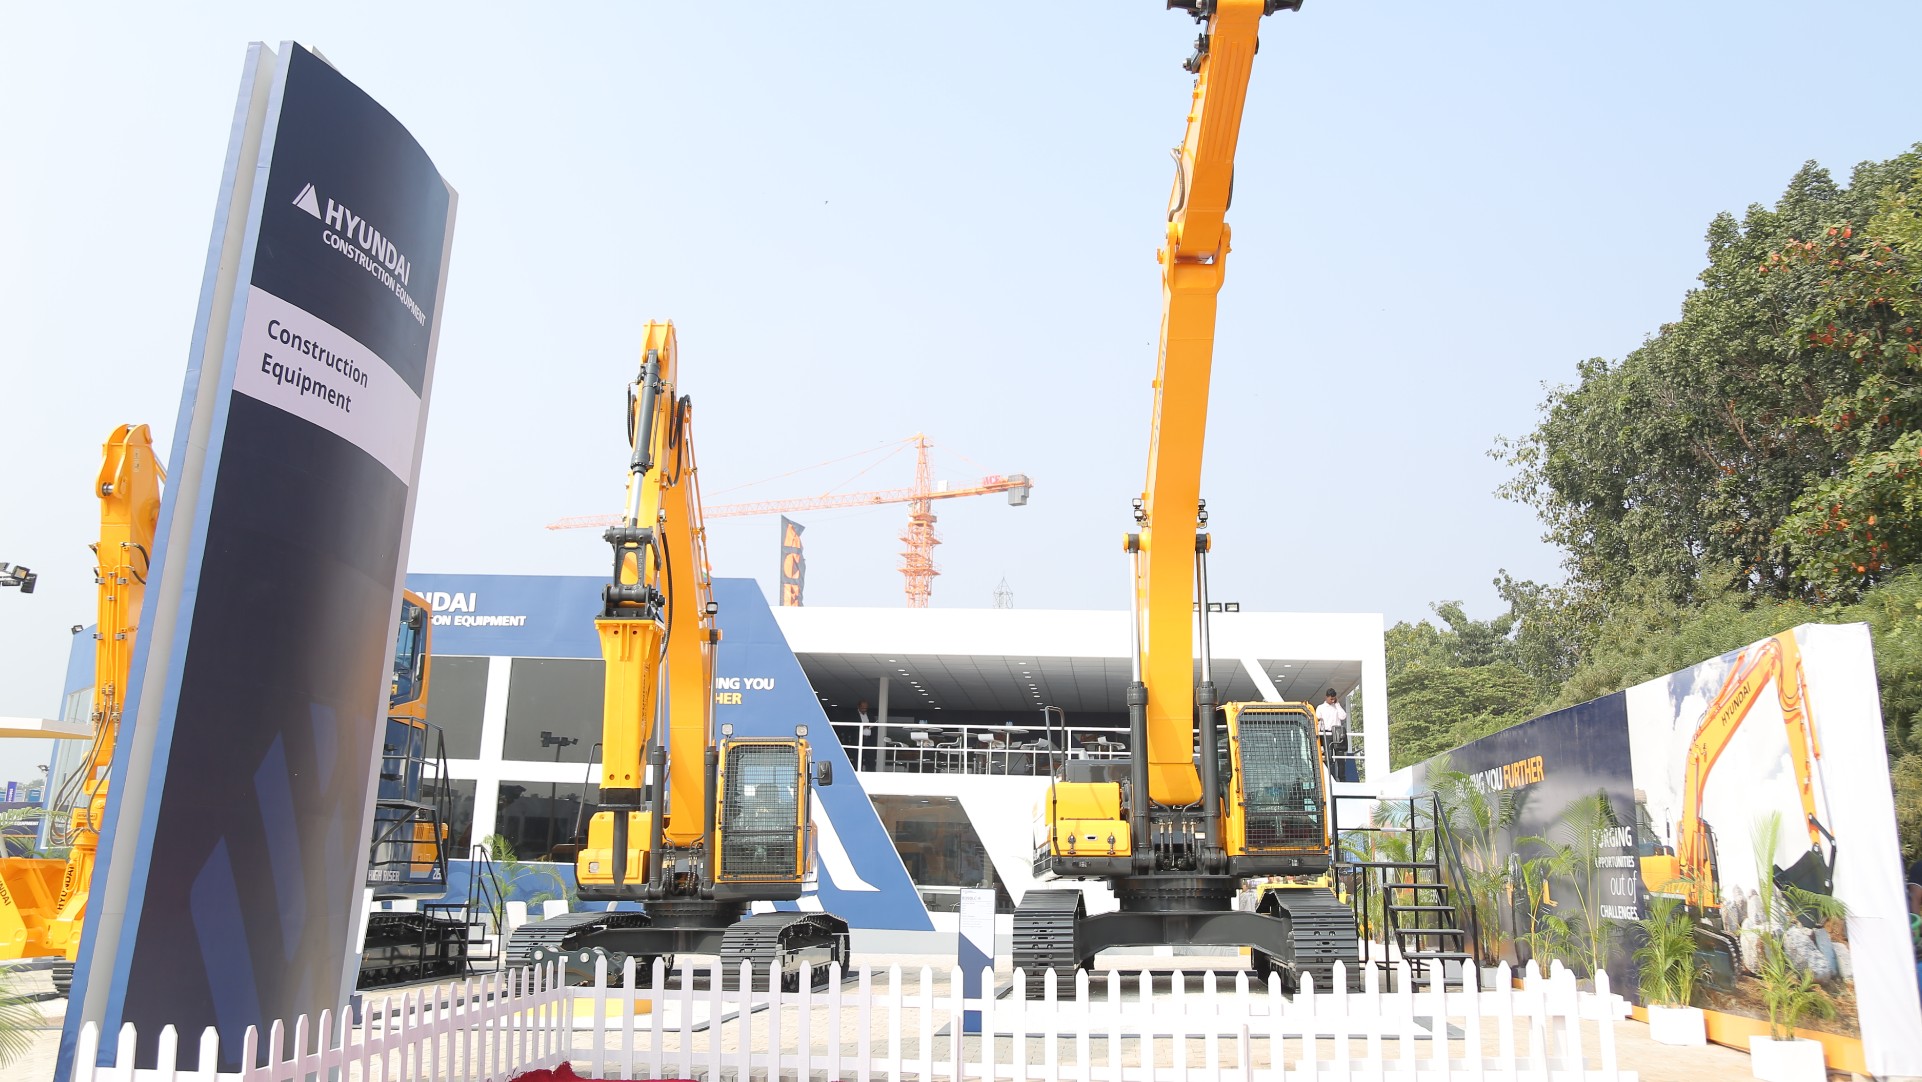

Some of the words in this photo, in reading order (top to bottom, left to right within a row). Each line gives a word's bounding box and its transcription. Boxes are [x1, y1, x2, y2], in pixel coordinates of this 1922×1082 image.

[325, 198, 411, 286] HYUNDAI
[323, 230, 396, 291] CONSTRUCTION
[395, 285, 426, 326] EQUIPMENT
[267, 319, 369, 388] Construction
[261, 352, 352, 413] Equipment
[454, 615, 527, 627] EQUIPMENT
[743, 678, 775, 690] YOU
[1721, 681, 1751, 726] HYUNDAI
[1485, 766, 1503, 793] YOU
[1503, 755, 1545, 790] FURTHER
[57, 866, 74, 910] HYUNDAI
[1610, 874, 1626, 896] out
[1627, 870, 1638, 904] of
[1600, 904, 1640, 921] CHALLENGES.
